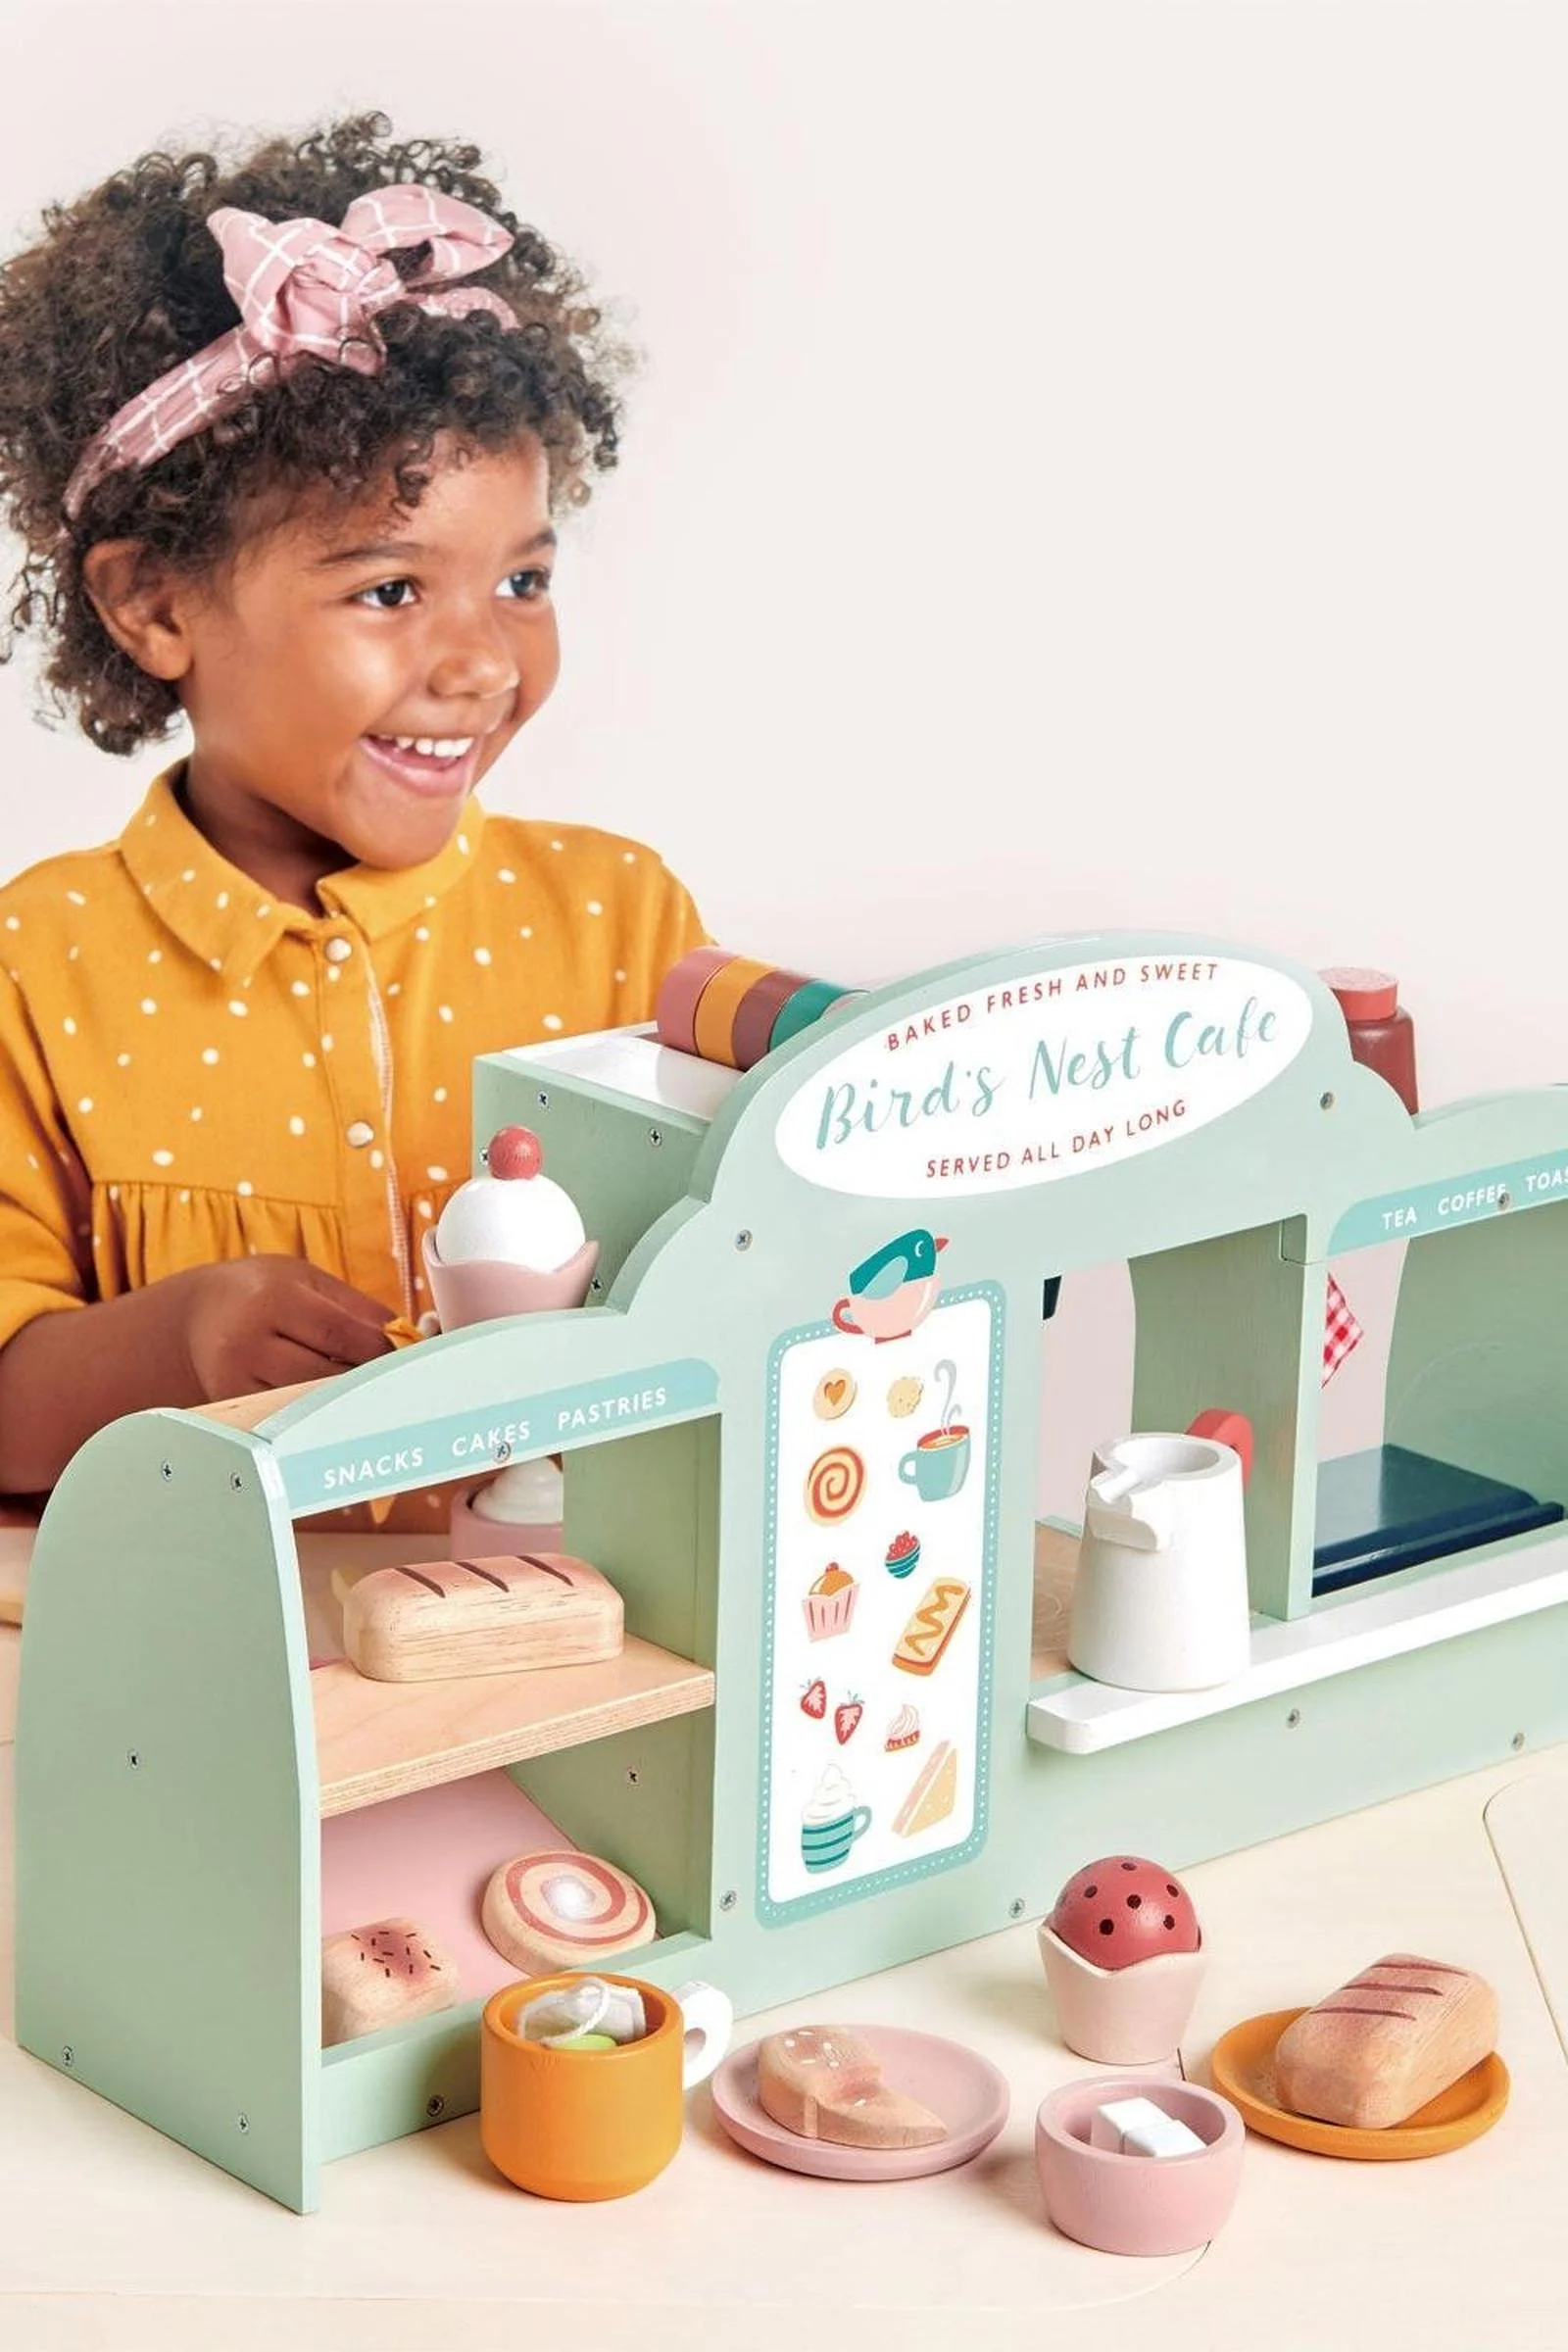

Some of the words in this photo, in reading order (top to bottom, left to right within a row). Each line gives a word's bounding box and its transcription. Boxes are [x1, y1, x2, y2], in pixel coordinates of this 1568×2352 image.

[886, 1004, 971, 1052] BAKED
[987, 978, 1062, 1013] FRESH
[1076, 966, 1125, 991] AND
[1141, 962, 1218, 983] SWEET
[815, 1060, 1004, 1150] Bird's
[1028, 1026, 1141, 1100] Nest
[1164, 996, 1277, 1068] Cafe
[926, 1152, 1010, 1178] SERVED
[1021, 1142, 1060, 1166] ALL
[1072, 1126, 1115, 1153] DAY
[1127, 1100, 1187, 1137] LONG
[1383, 1206, 1417, 1230] TEA
[323, 1447, 423, 1490] SNACKS
[452, 1421, 530, 1456] CAKES
[558, 1387, 666, 1431] PASTRIES
